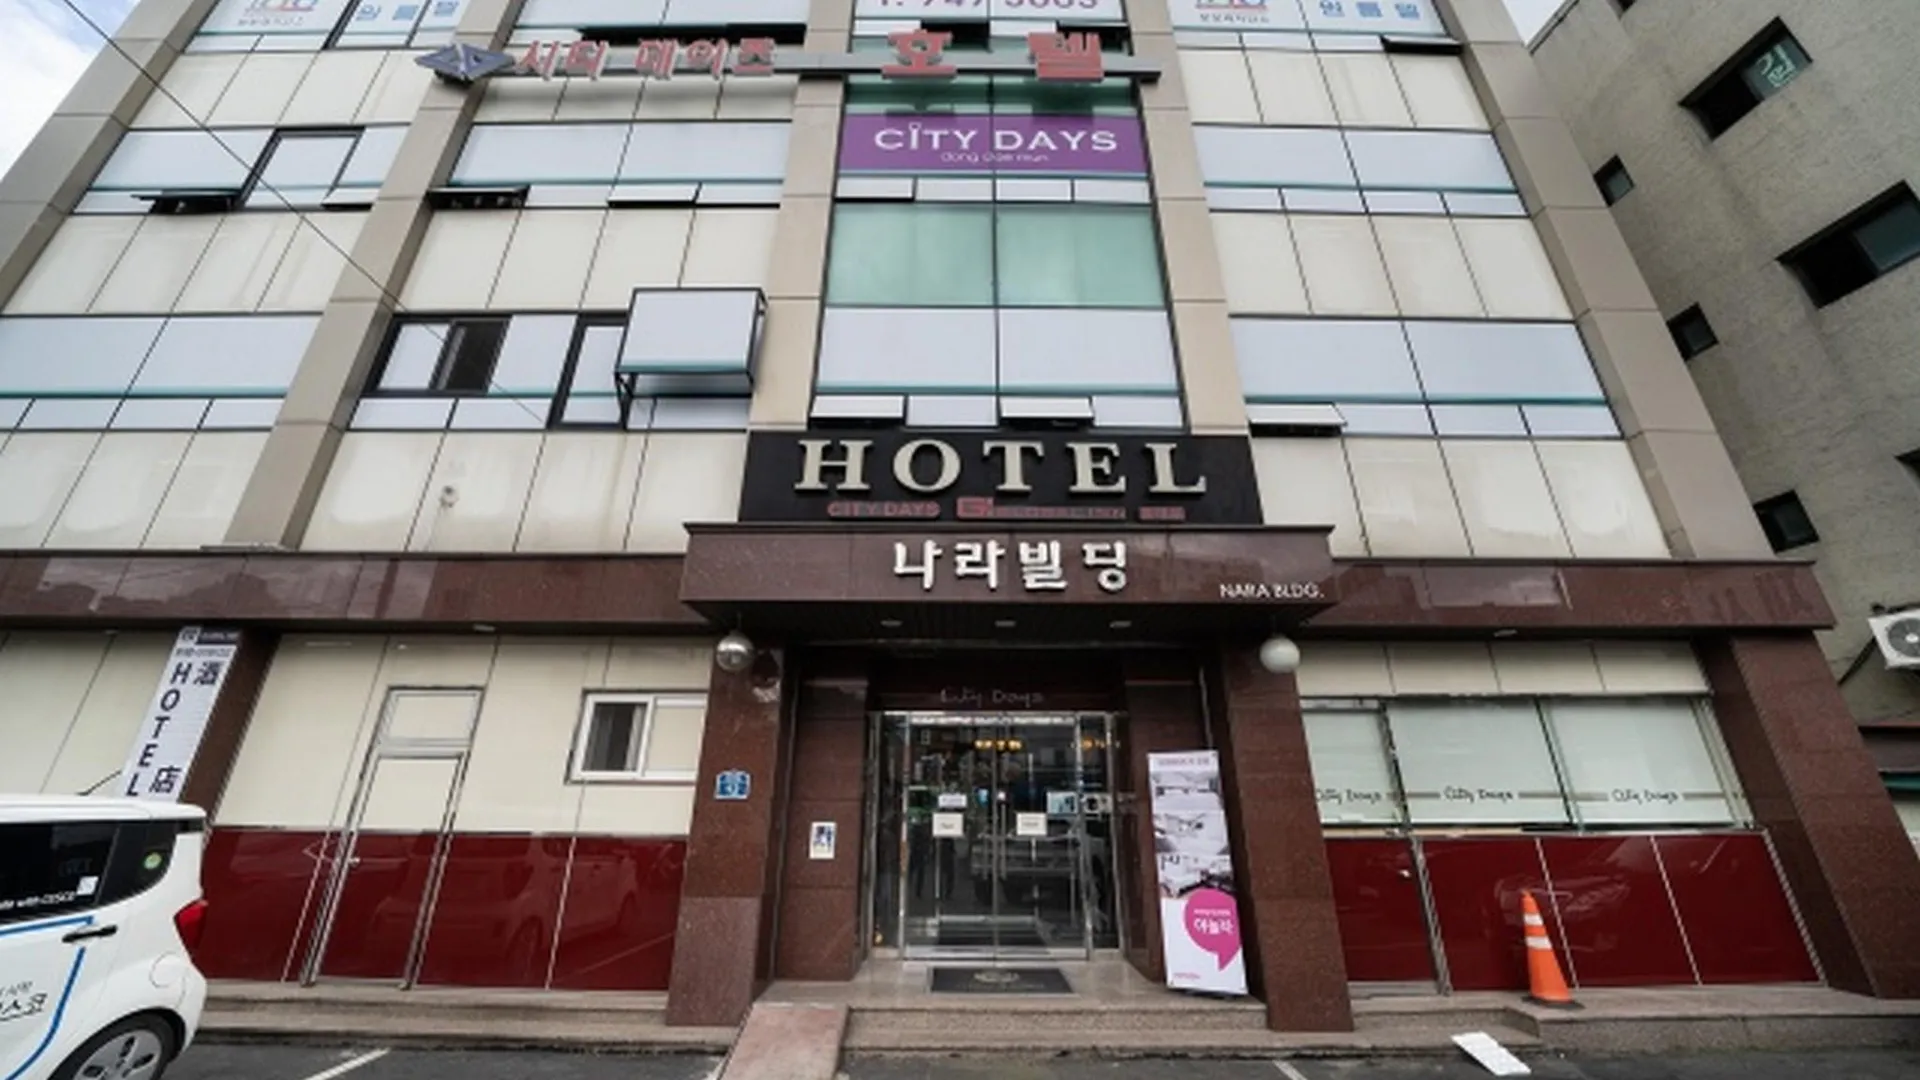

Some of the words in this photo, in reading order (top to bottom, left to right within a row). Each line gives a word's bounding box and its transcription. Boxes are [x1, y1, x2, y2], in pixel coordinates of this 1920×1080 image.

[875, 122, 978, 151] CITY
[995, 130, 1118, 151] DAYS
[794, 439, 1207, 495] HOTEL
[883, 501, 941, 517] DAYS
[893, 538, 1129, 592] 나라빌딩
[1219, 583, 1271, 599] NARA
[126, 661, 193, 797] HOTEL
